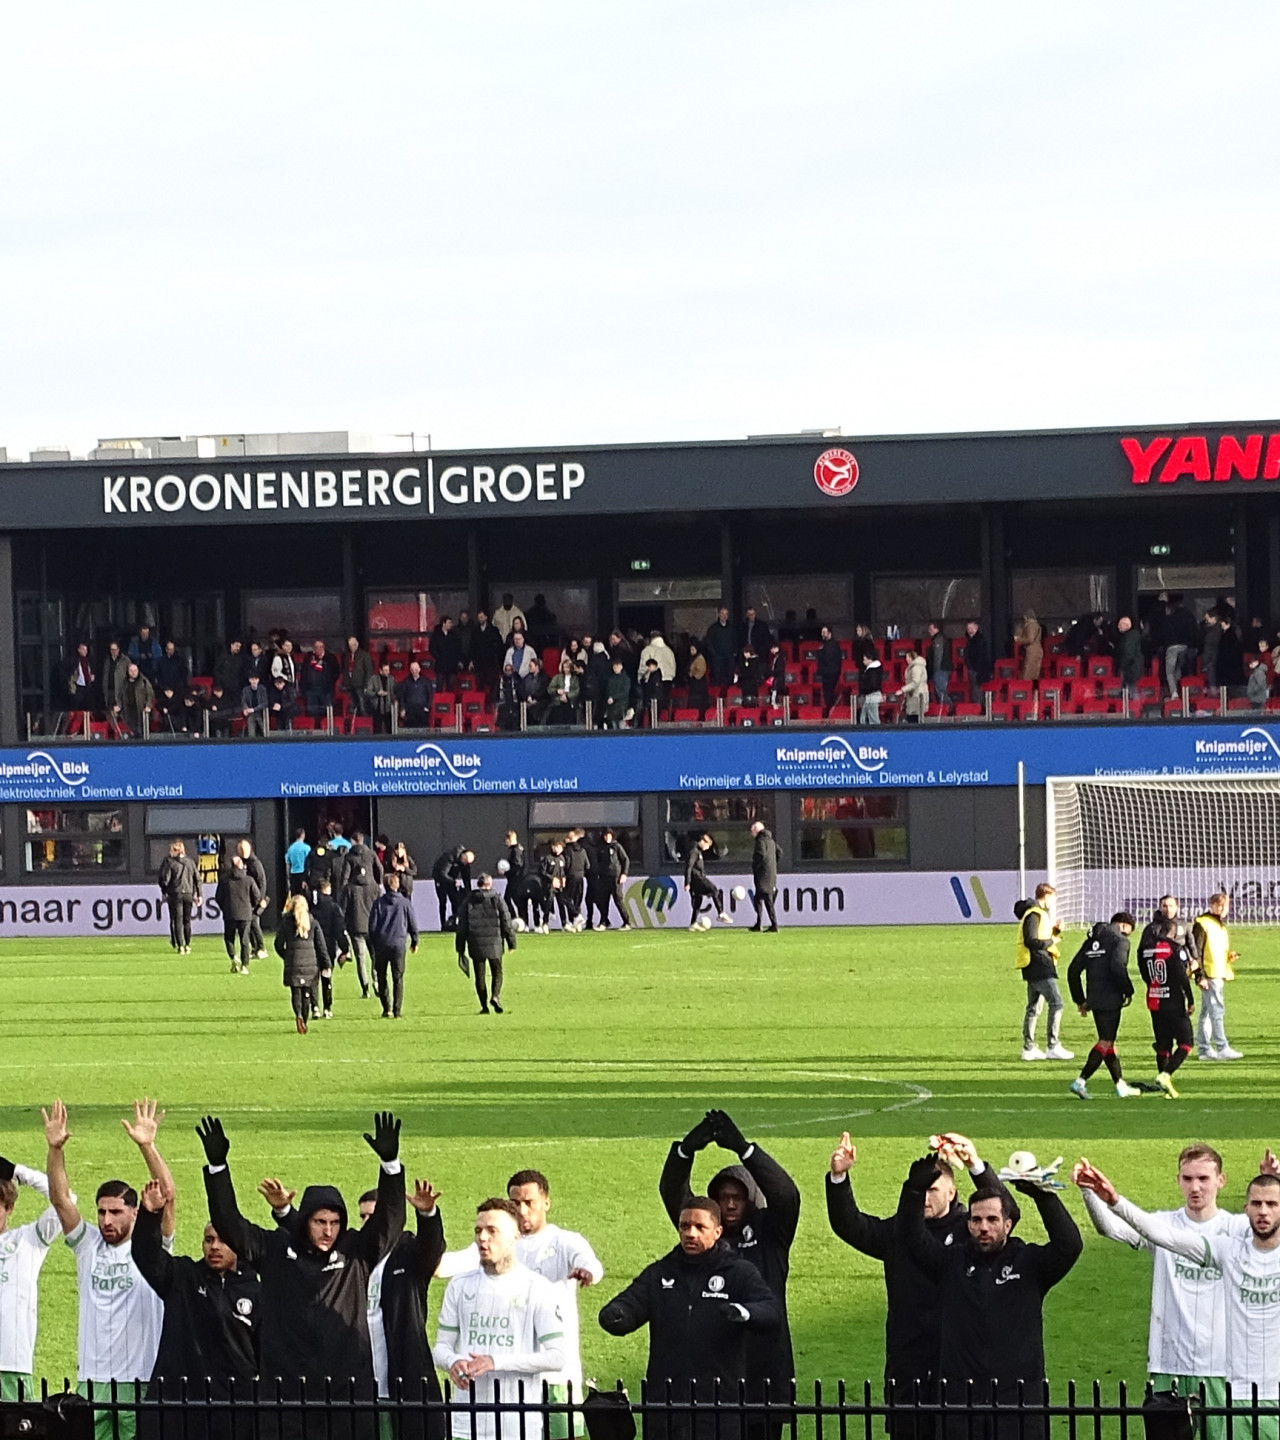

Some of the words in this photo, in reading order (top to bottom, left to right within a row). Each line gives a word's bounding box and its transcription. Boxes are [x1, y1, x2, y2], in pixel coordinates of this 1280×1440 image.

[103, 467, 421, 513] KROONENBERG
[439, 462, 585, 504] GROEP
[777, 748, 846, 762] Knipmeijer
[859, 747, 888, 759] Blok
[1196, 740, 1267, 755] Knipmeijer
[63, 762, 89, 774] Blok
[374, 756, 441, 769] Knipmeijer
[453, 754, 481, 767] Blok
[281, 783, 339, 796] Knipmeijer
[342, 782, 351, 793] &
[354, 780, 378, 793] Blok
[381, 779, 467, 792] elektrotechniek
[473, 778, 516, 791] Diemen
[519, 778, 527, 789] &
[531, 777, 578, 792] Lelystad
[680, 775, 741, 789] Knipmeijer
[744, 775, 752, 786] &
[756, 773, 781, 786] Blok
[784, 771, 872, 785] elektrotechniek
[880, 771, 924, 783] Diemen
[928, 771, 936, 782] &
[939, 770, 988, 785] Lelystad
[82, 786, 122, 798] Diemen
[126, 785, 134, 797] &
[138, 785, 183, 799] Lelystad
[1146, 959, 1167, 985] 19
[1174, 1263, 1223, 1281] Parcs
[91, 1274, 133, 1290] Parcs
[470, 1312, 509, 1329] Euro
[468, 1330, 514, 1347] Parcs
